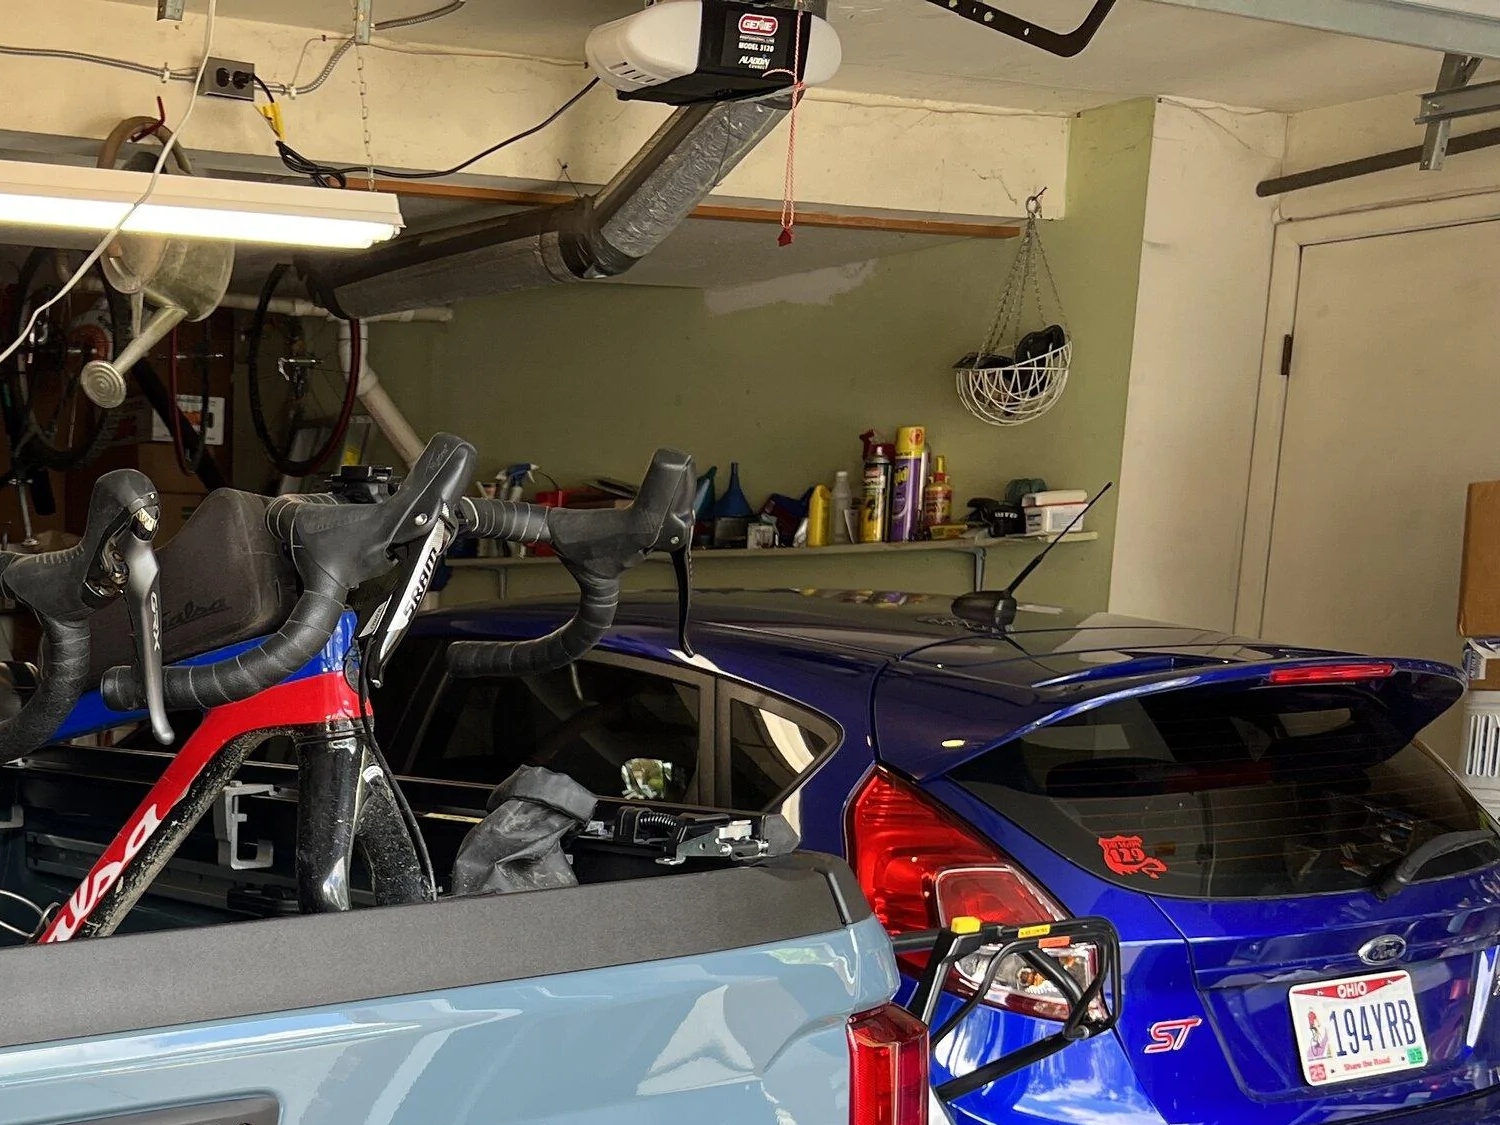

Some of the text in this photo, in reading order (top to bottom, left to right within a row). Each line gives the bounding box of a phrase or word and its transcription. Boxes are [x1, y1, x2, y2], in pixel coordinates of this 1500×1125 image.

[743, 19, 773, 31] GENIE
[738, 42, 759, 51] MODEL
[403, 547, 437, 621] SRAM
[150, 591, 161, 652] GRX
[46, 803, 163, 943] alsa
[1337, 981, 1367, 999] OHIO
[1144, 1016, 1203, 1054] ST
[1329, 1000, 1416, 1057] 194YRB
[1343, 1056, 1391, 1071] Share the Road
